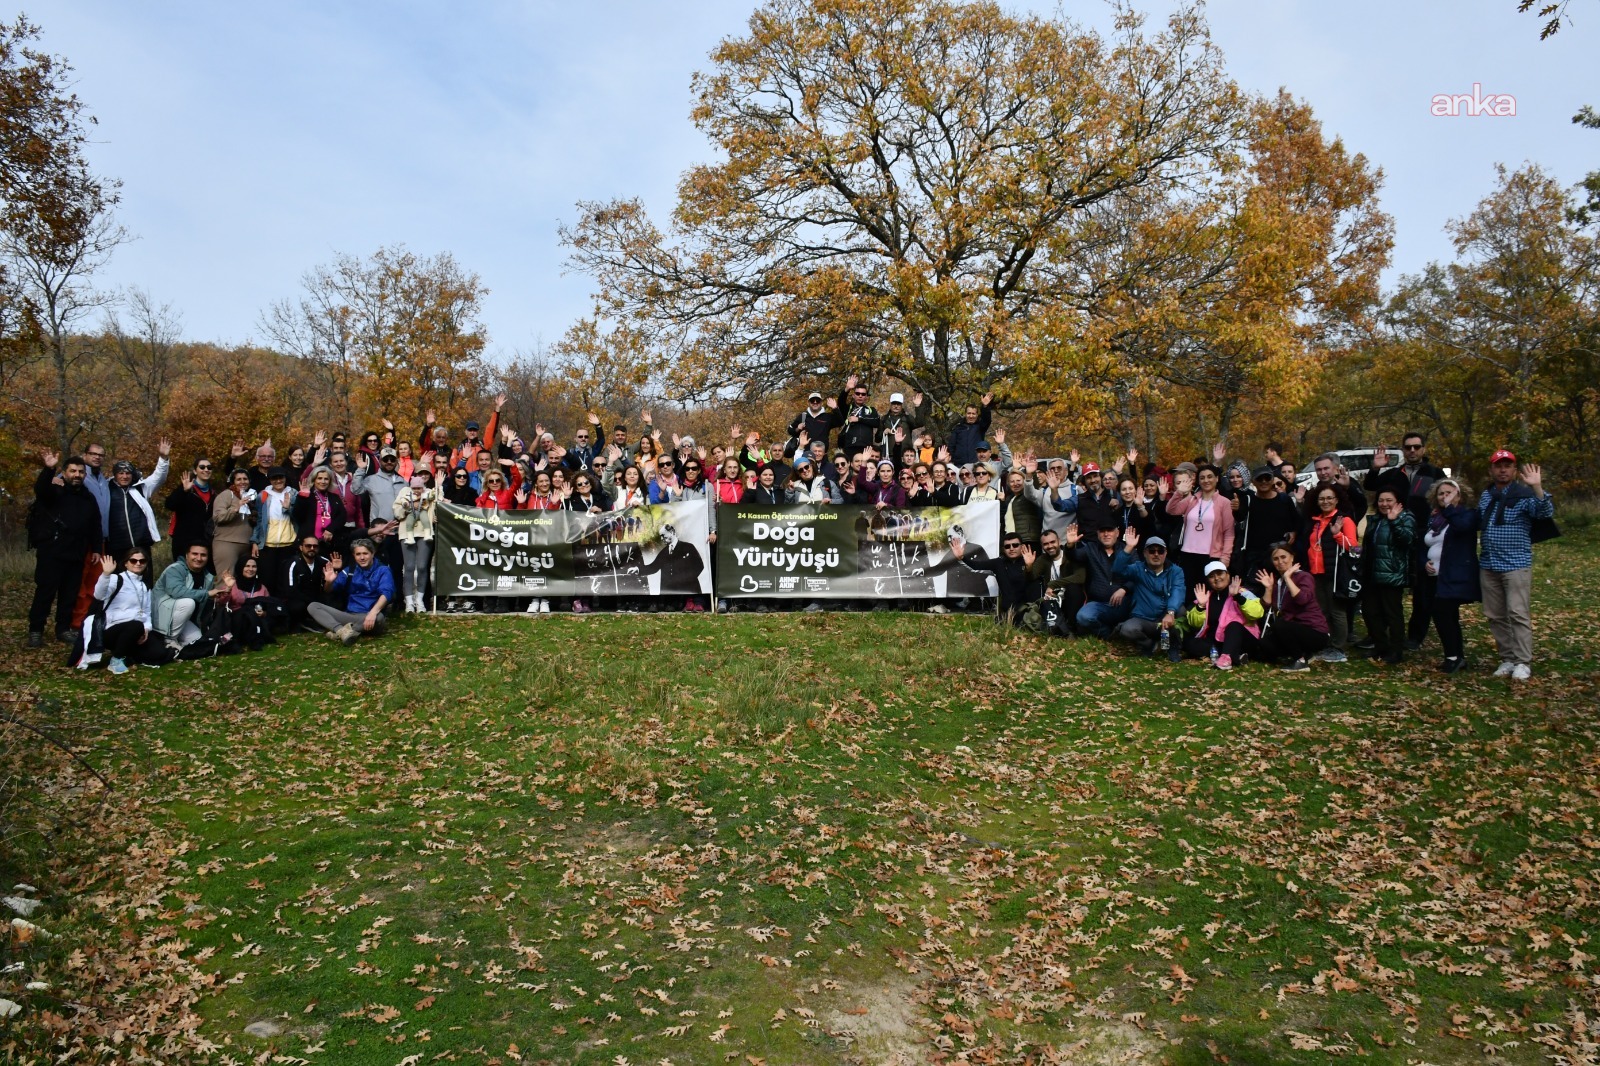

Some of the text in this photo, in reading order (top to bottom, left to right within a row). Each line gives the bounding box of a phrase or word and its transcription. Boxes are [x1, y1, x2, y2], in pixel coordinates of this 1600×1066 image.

[464, 515, 487, 523] Kasım
[771, 511, 818, 521] Öğretmenler
[469, 523, 529, 547] Doğa
[753, 521, 815, 545] Doğa
[450, 547, 555, 573] Yürüyüşü
[732, 547, 840, 573] Yürüyüşü
